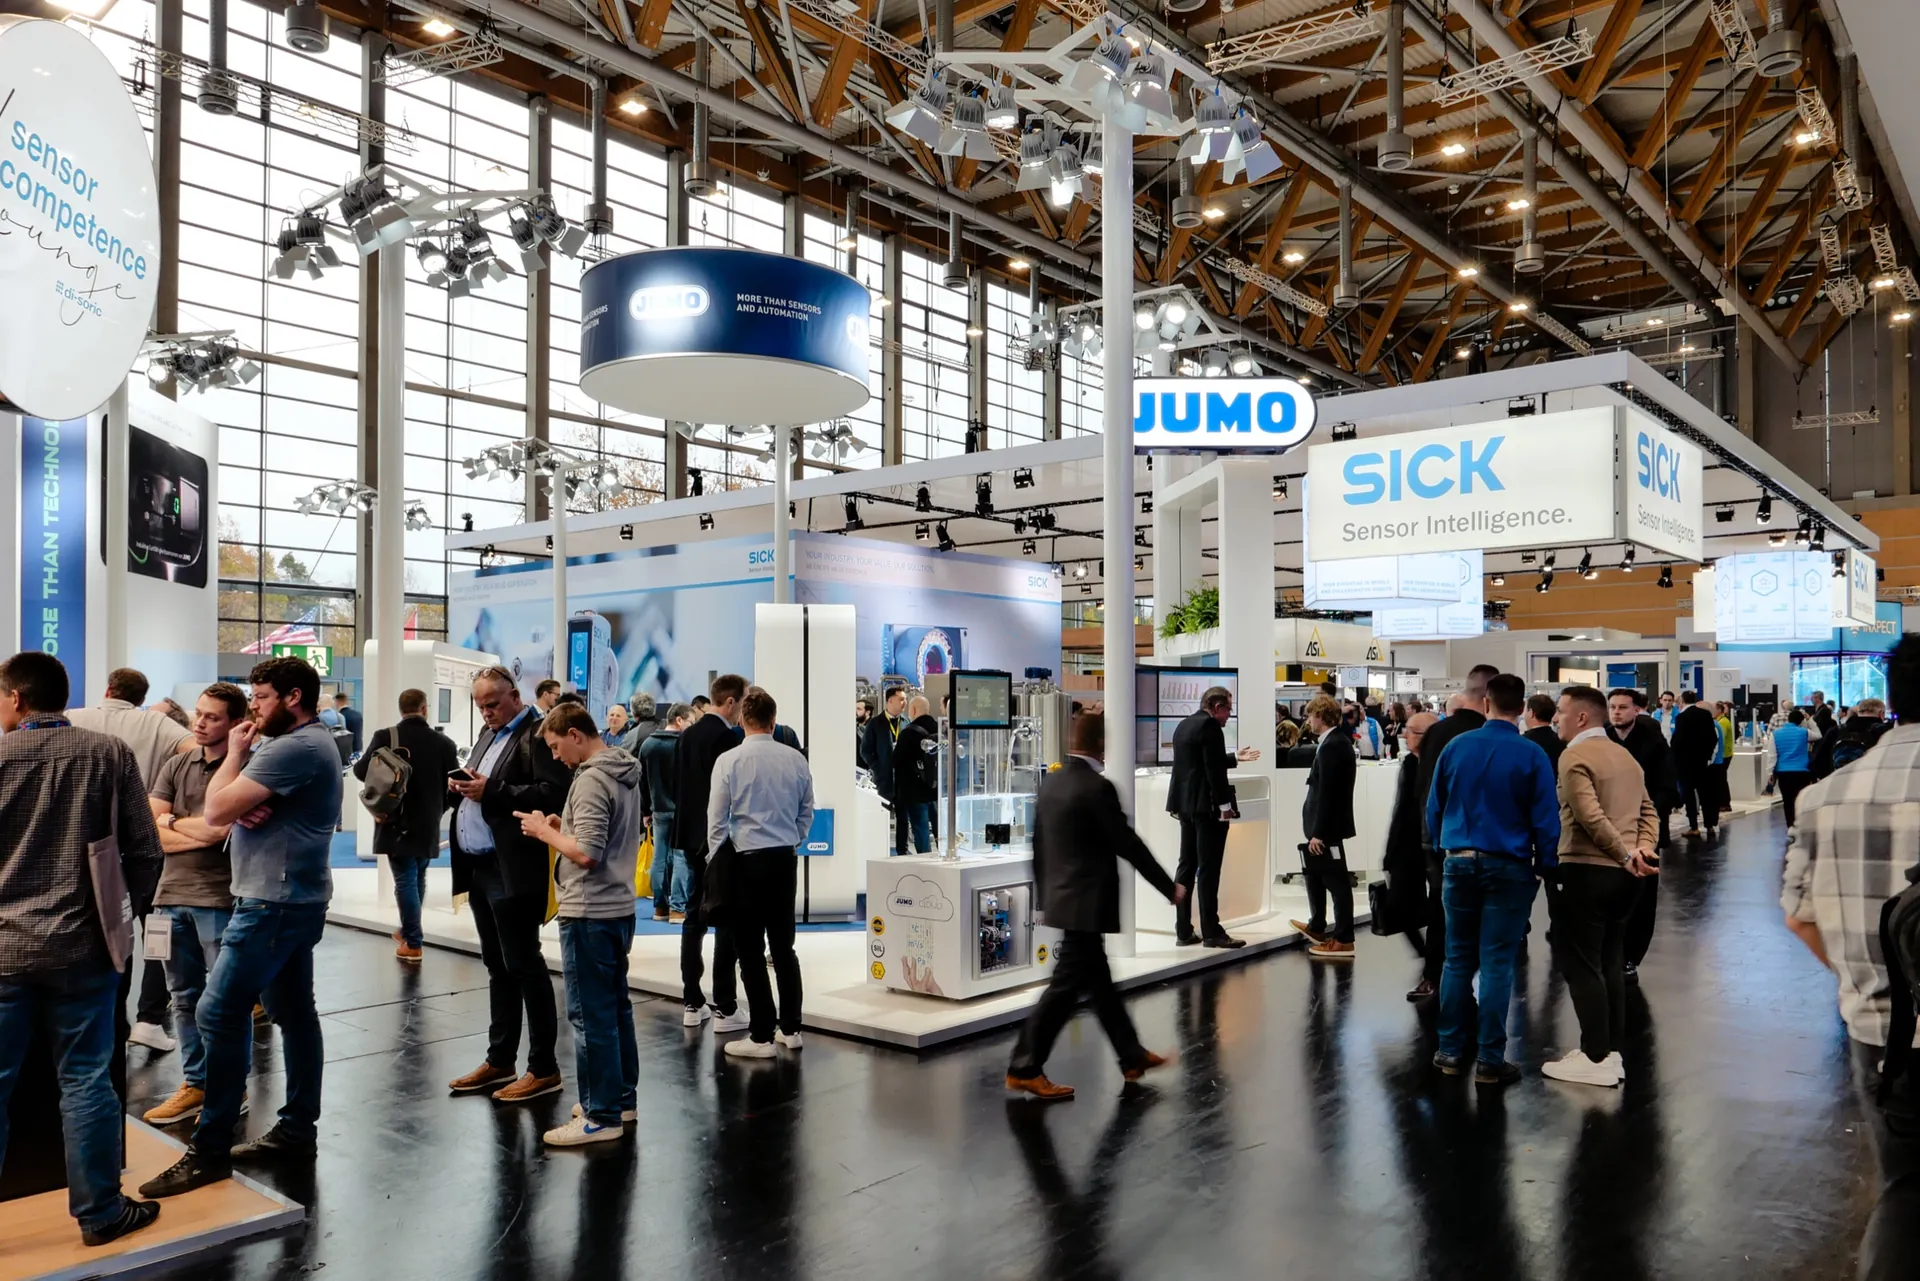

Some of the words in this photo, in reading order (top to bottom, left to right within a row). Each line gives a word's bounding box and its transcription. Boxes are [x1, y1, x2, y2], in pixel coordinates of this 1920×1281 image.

[11, 120, 99, 202] sensor
[0, 159, 146, 280] competence
[64, 287, 103, 317] di-soric
[636, 291, 701, 313] JO
[736, 293, 762, 304] MORE
[764, 295, 787, 307] THAN
[788, 300, 822, 315] SENSORS
[736, 303, 755, 313] AND
[757, 305, 809, 322] AUTOMATION
[1133, 391, 1297, 434] JUMO
[1342, 436, 1506, 506] SICK
[1637, 431, 1681, 503] SICK
[1342, 521, 1419, 542] Sensor
[1427, 508, 1573, 535] Intelligence.
[1637, 504, 1661, 532] Sensor
[43, 532, 59, 600] THAN
[749, 549, 775, 564] SICK
[1028, 576, 1048, 588] SICK
[1854, 559, 1869, 594] SICK
[42, 607, 59, 657] ORE
[896, 898, 913, 906] JUMO
